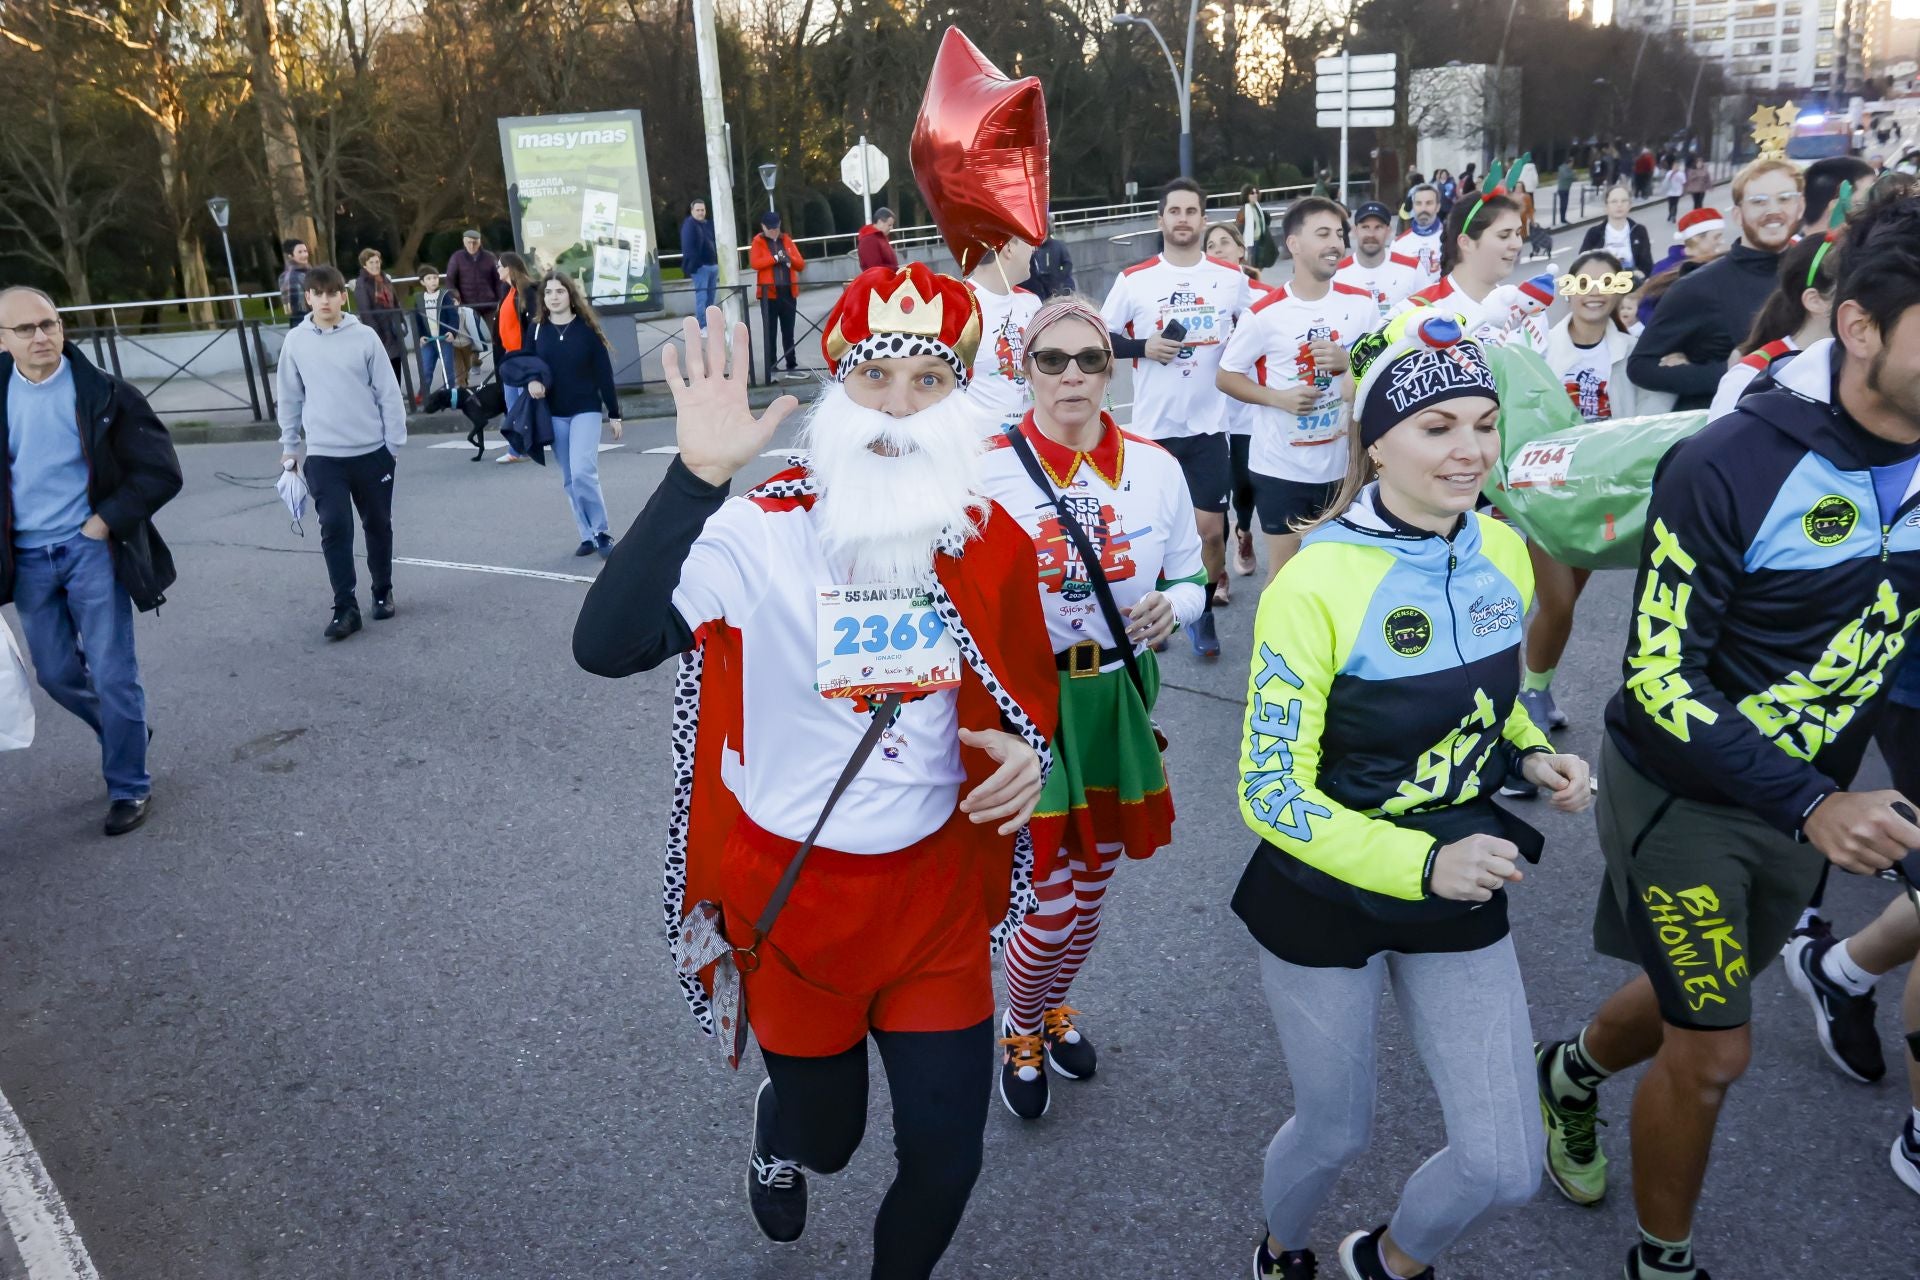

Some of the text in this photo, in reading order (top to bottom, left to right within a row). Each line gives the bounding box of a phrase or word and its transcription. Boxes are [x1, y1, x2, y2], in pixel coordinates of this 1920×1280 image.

[517, 128, 627, 149] masymas
[519, 177, 565, 188] DESCARGA
[519, 186, 578, 197] NUESTRA APP
[1559, 270, 1634, 296] 2025
[1297, 410, 1339, 430] 3747
[1521, 447, 1566, 466] 1764
[1075, 498, 1099, 513] 55
[844, 586, 926, 602] 55 SAN SILVE
[1393, 611, 1419, 619] SENSEY
[833, 611, 945, 656] 2369
[1626, 517, 1719, 742] SENSEY
[1401, 645, 1422, 653] SKOOL
[1736, 579, 1899, 738] ENSEY
[1244, 641, 1333, 842] SENSEY
[1676, 884, 1749, 987] BIKE
